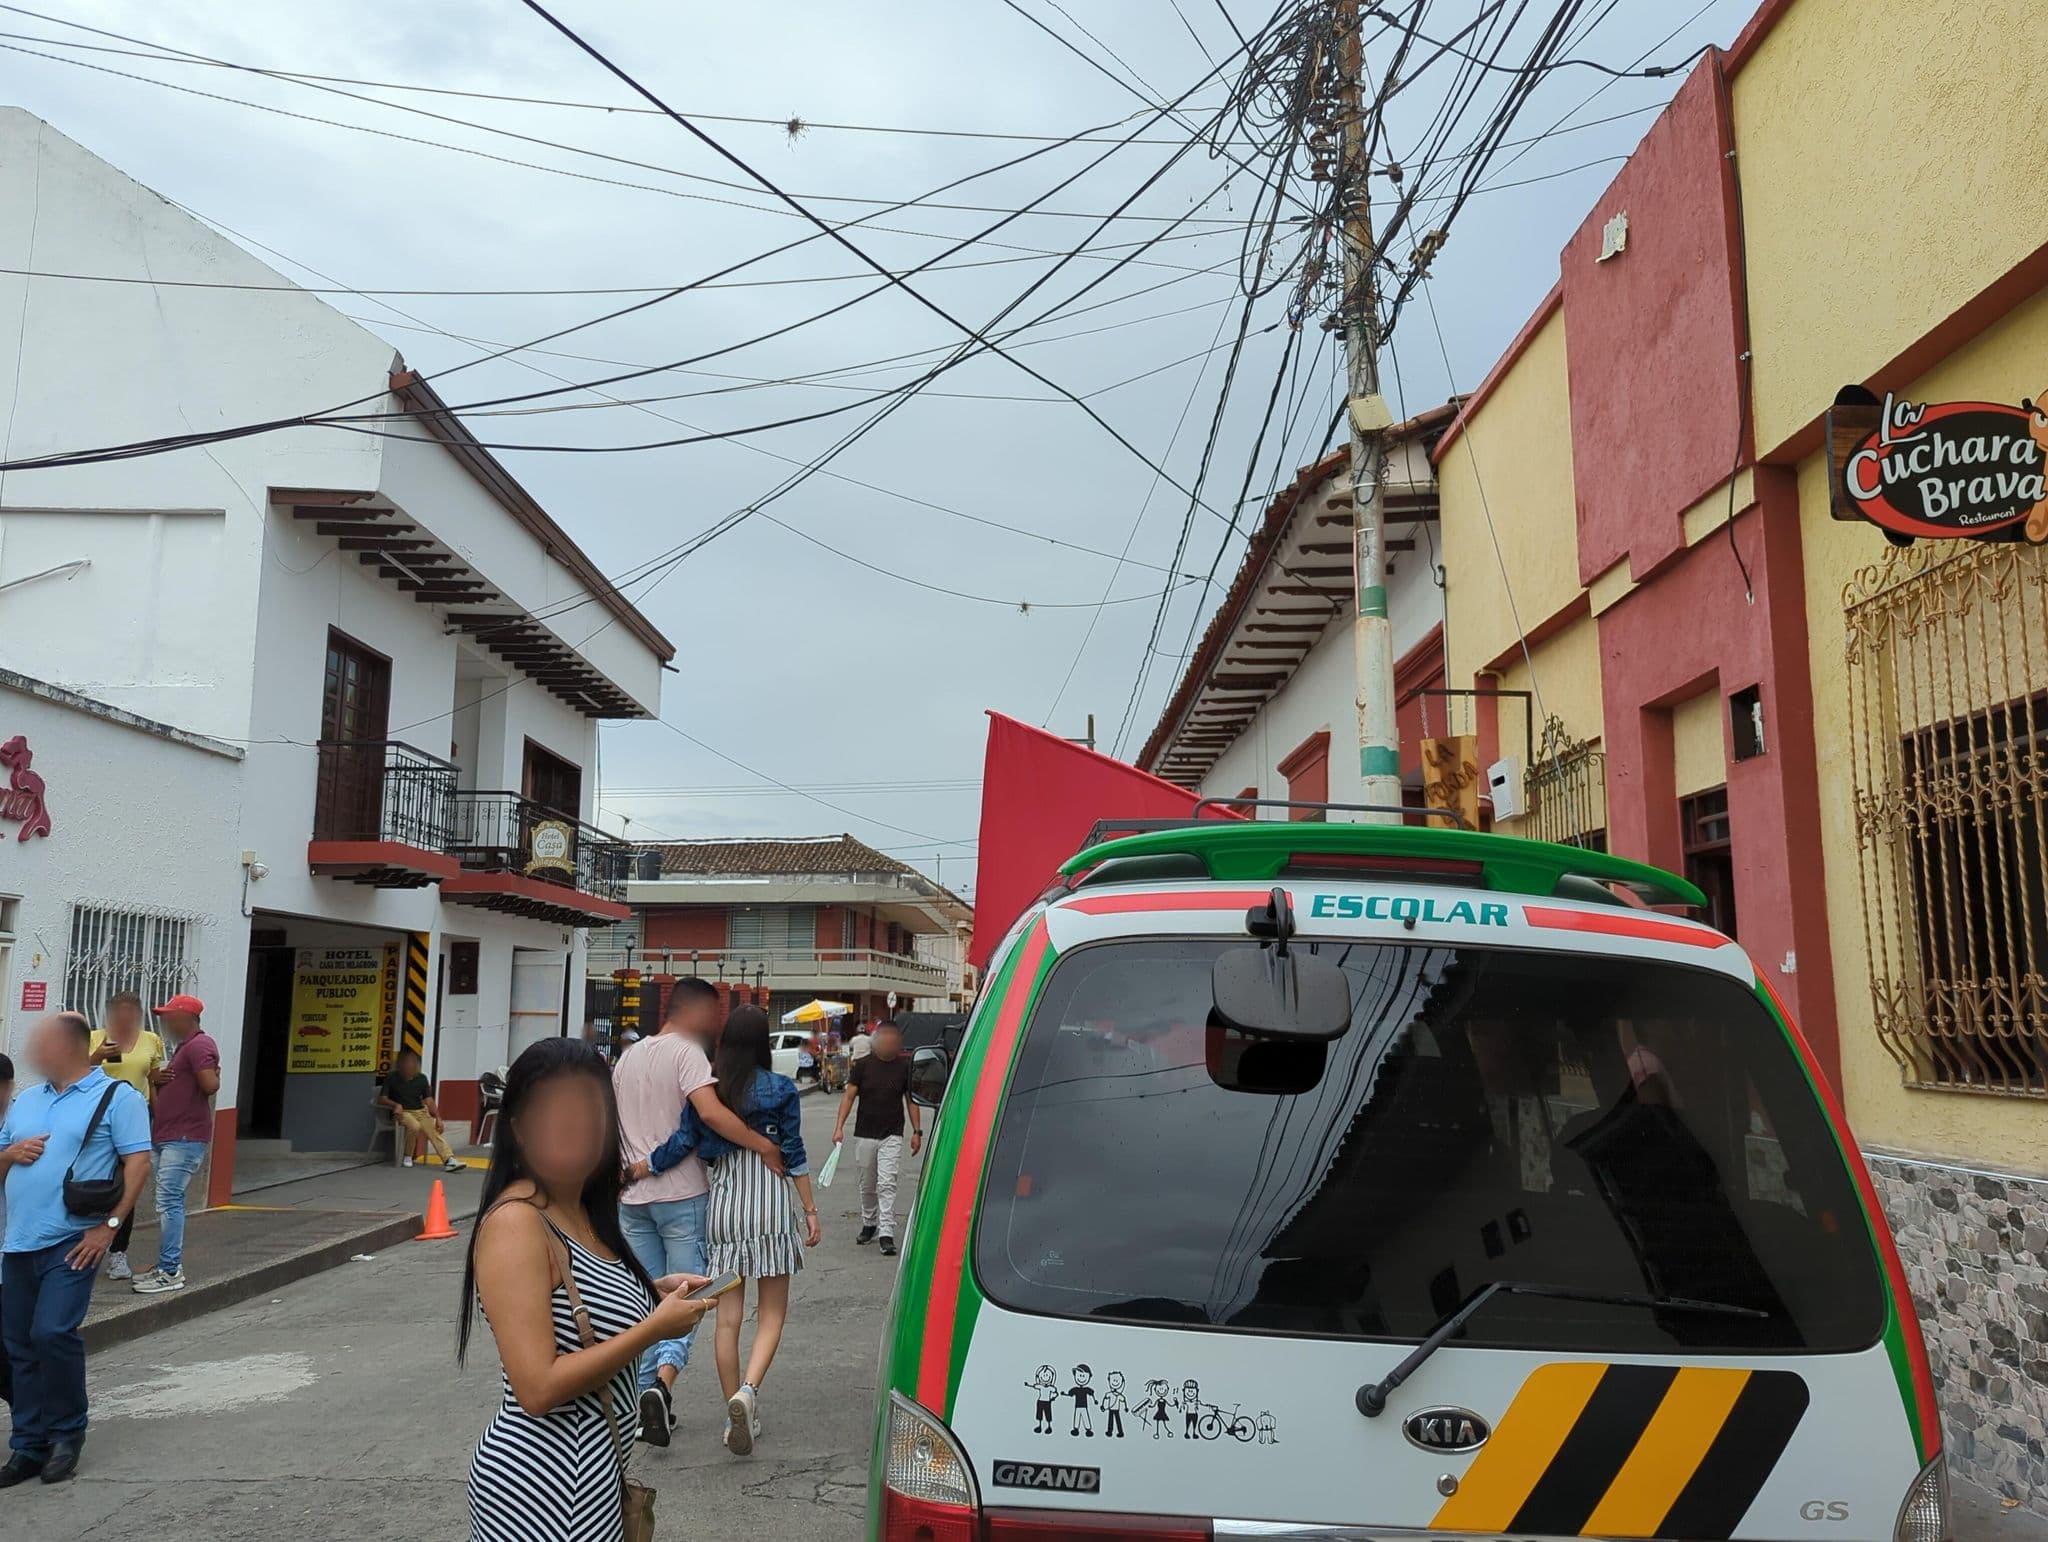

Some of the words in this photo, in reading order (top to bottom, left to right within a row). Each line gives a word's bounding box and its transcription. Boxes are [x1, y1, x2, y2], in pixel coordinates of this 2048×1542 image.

[1880, 392, 1927, 448] La
[1846, 432, 2039, 500] Cuchara
[1917, 471, 2047, 518] Brava
[1958, 506, 2016, 526] Restaurant
[537, 840, 563, 849] Casa
[1310, 894, 1508, 927] ESCOLAR
[326, 950, 373, 960] HOTEL
[300, 974, 377, 986] PARQUEADERO
[1419, 1417, 1478, 1443] KIA
[995, 1464, 1097, 1489] GRAND
[1799, 1500, 1849, 1521] GS
